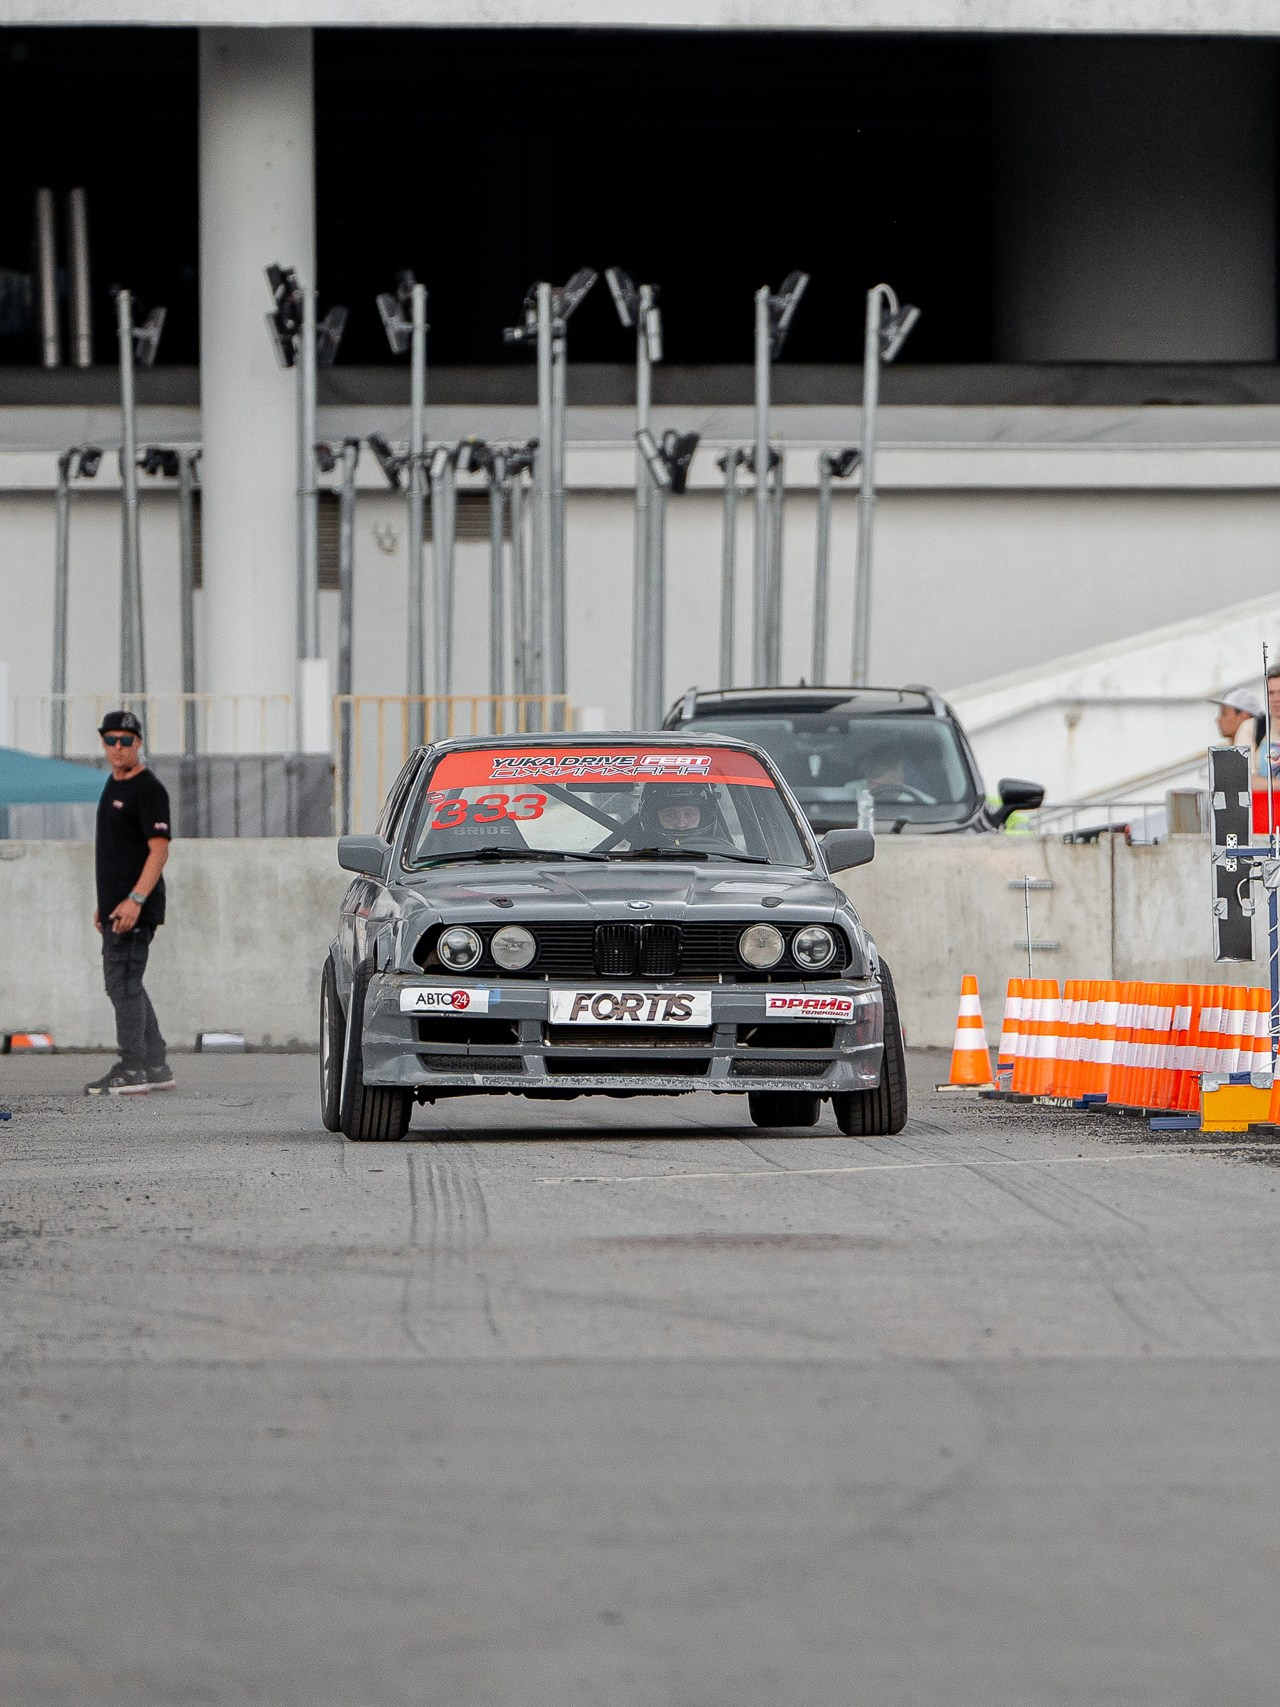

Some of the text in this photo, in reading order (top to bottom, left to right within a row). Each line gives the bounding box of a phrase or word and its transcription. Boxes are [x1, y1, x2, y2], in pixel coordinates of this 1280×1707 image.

[492, 755, 709, 769] YUKA DRIVE FEST
[431, 793, 548, 830] 333
[453, 825, 511, 836] BRIDE
[568, 992, 696, 1022] FORTIS
[768, 997, 853, 1011] ДРАЙВ
